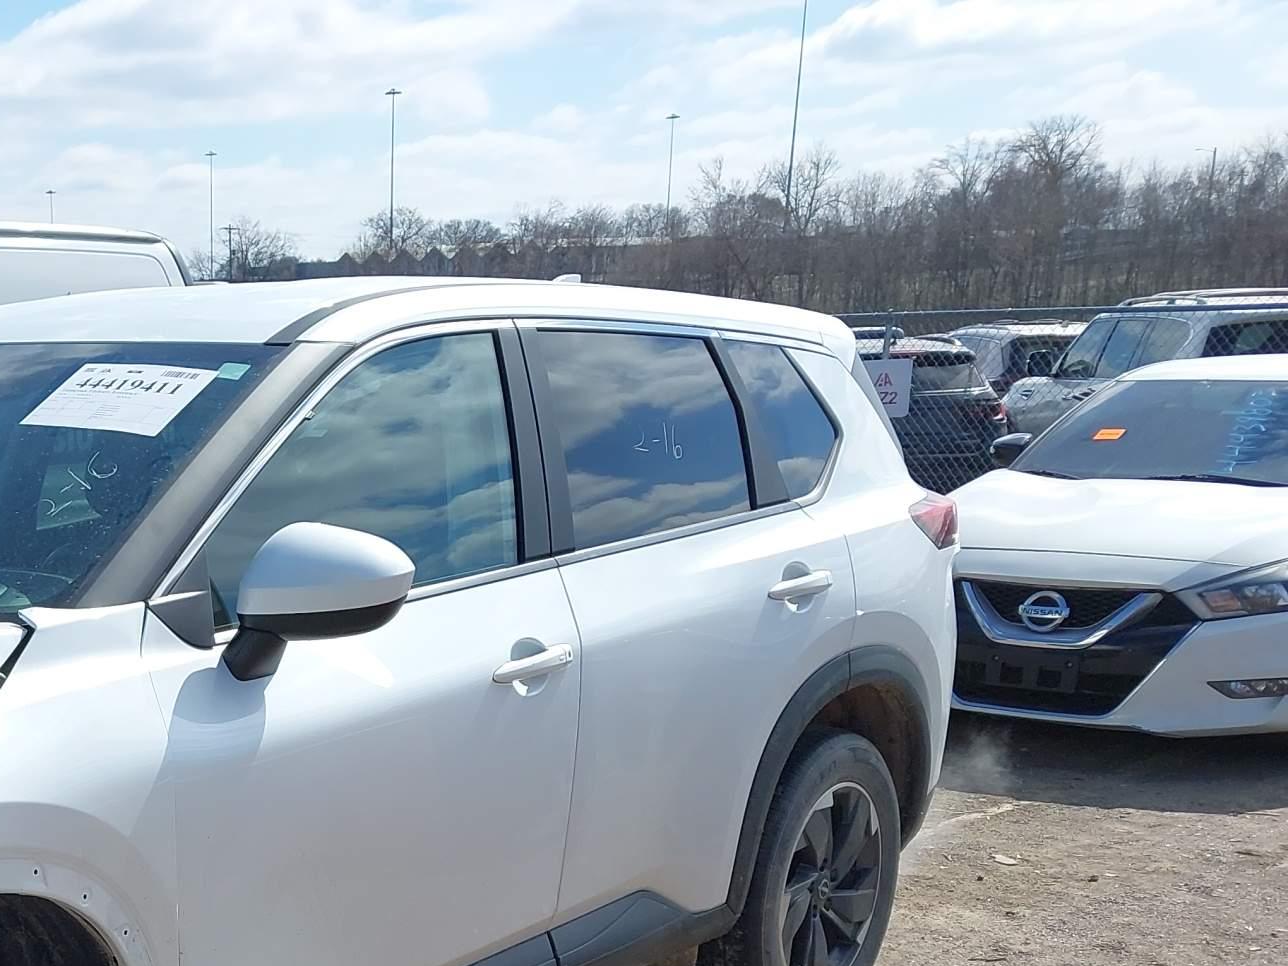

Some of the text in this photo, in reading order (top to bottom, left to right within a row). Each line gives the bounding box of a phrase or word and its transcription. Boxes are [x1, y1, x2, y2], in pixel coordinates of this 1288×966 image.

[75, 376, 184, 395] 44419411
[632, 422, 684, 460] 2-16
[1021, 607, 1063, 617] NISSAN
